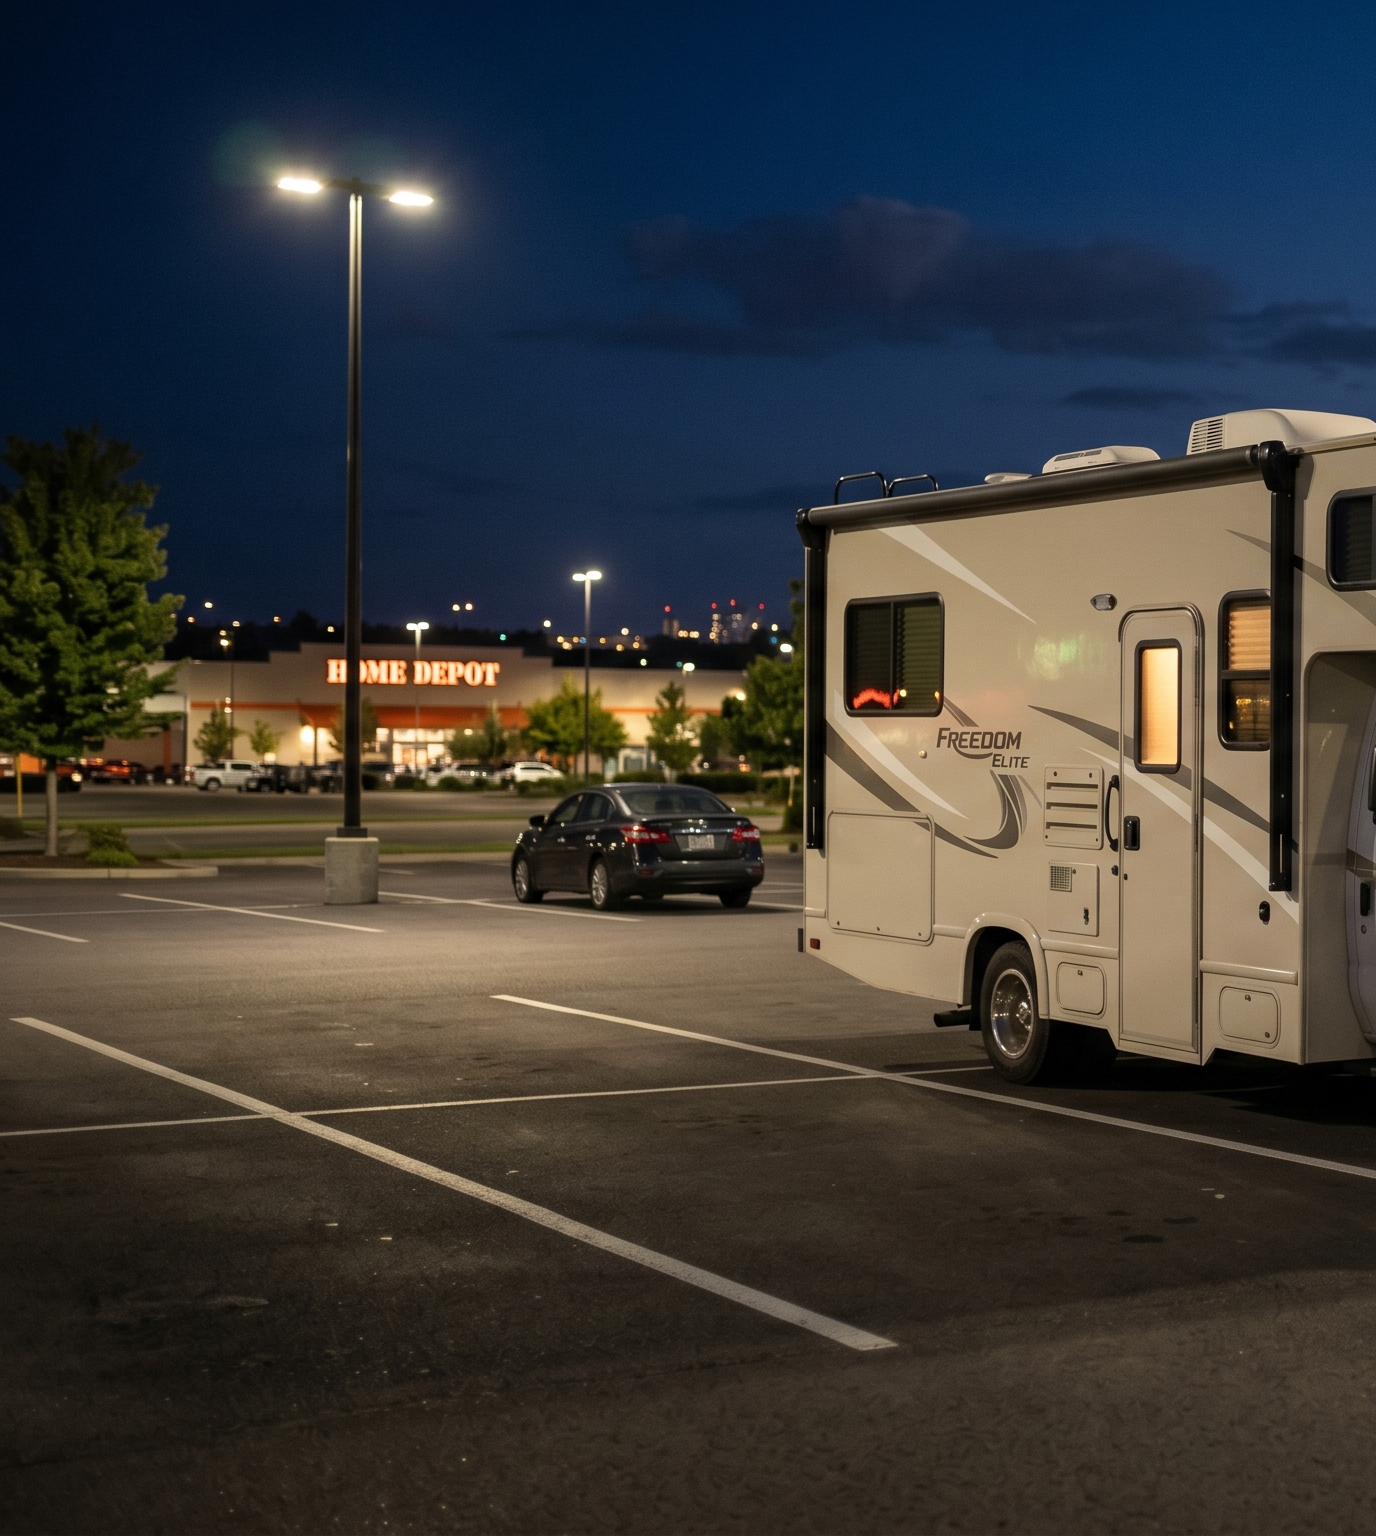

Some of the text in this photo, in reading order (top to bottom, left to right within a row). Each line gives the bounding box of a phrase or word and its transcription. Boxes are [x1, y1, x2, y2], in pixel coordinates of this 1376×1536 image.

[413, 660, 501, 687] DEPOT
[936, 727, 1022, 750] FREEDOM
[991, 753, 1031, 769] ELITE
